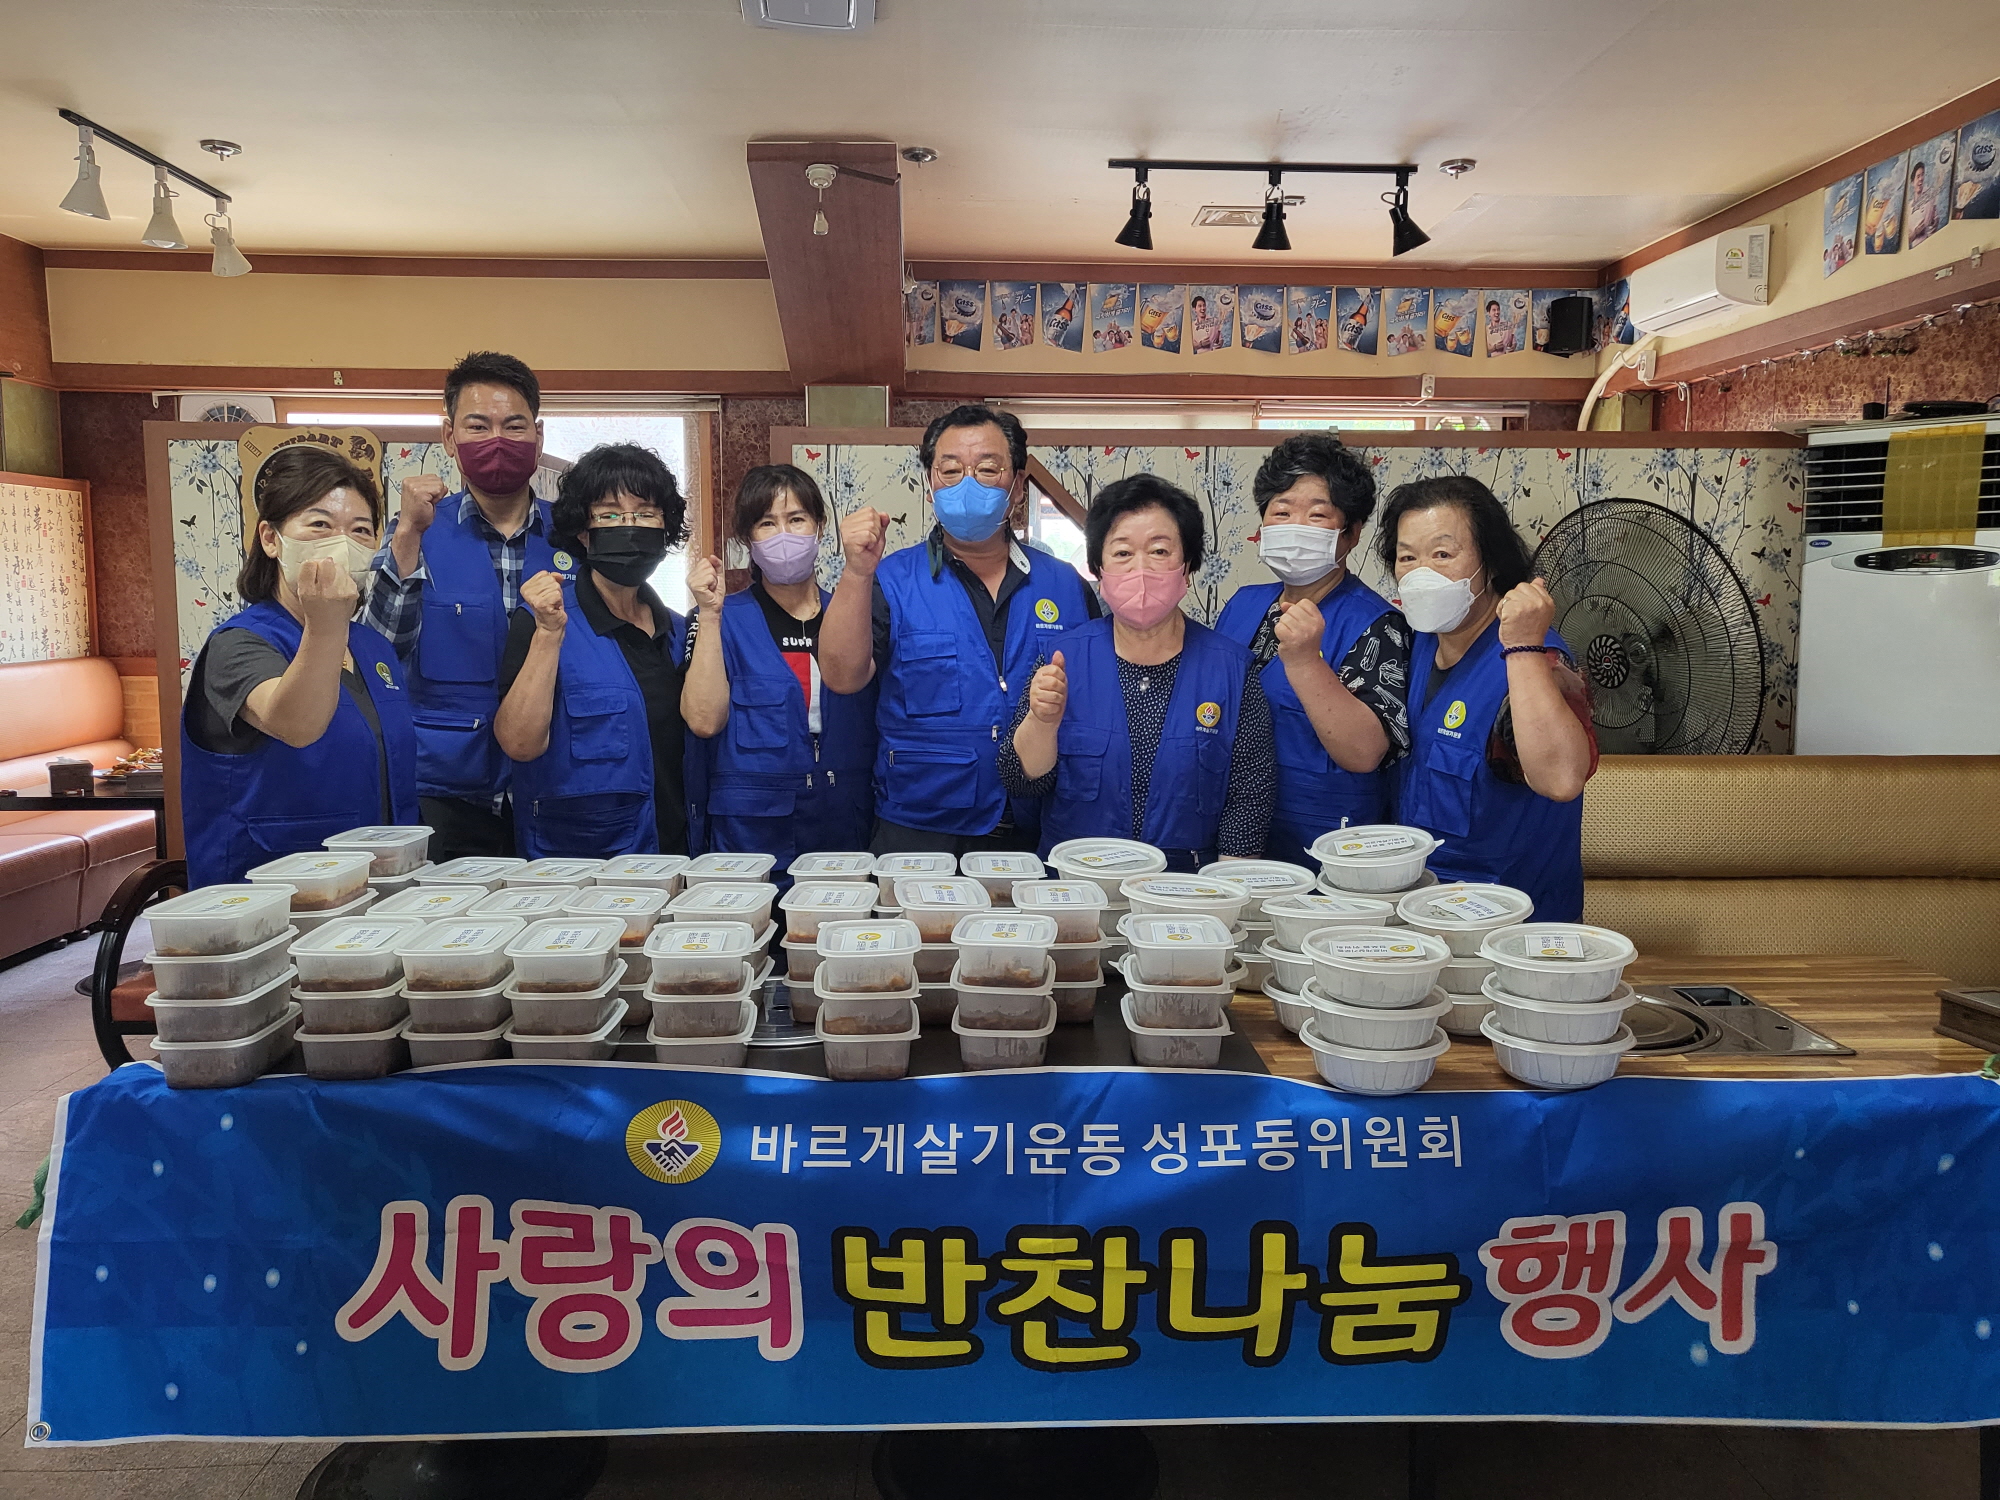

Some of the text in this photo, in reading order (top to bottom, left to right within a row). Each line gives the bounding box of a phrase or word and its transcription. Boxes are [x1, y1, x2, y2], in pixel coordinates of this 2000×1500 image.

[956, 298, 975, 307] Cass
[1015, 293, 1032, 304] 카스
[1310, 298, 1327, 309] 카스
[1255, 302, 1274, 311] Cass
[1148, 308, 1162, 318] Cass
[1441, 312, 1456, 322] Cass
[750, 1115, 1464, 1176] 바르게살기운동 성포동위원회
[335, 1194, 1778, 1375] 사랑의 반찬나눔 행사
